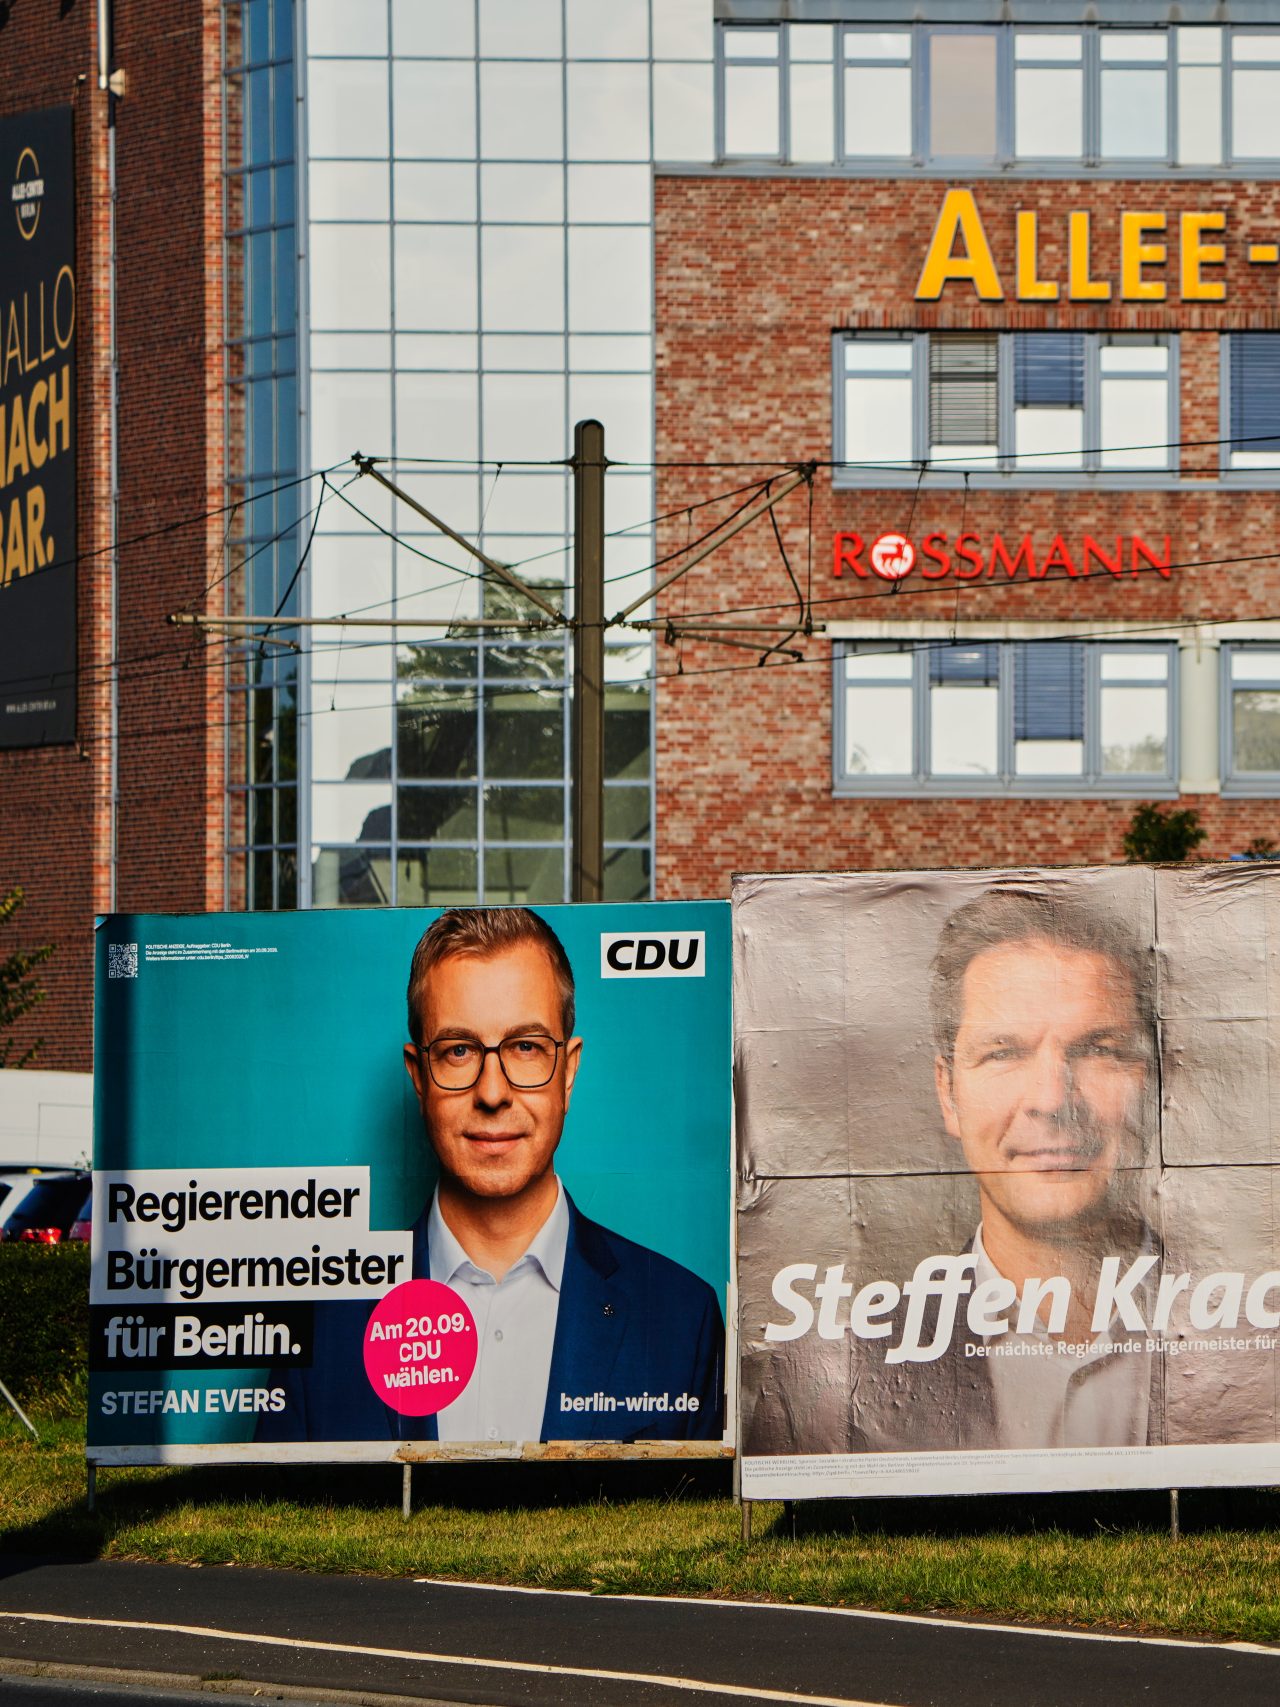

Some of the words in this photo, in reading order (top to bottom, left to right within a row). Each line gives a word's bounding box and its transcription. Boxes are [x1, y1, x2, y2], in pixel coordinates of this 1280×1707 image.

[0, 265, 75, 390] ALLO
[0, 364, 70, 488] ACH
[0, 485, 55, 588] AR.
[832, 531, 1172, 580] ROSSMANN
[606, 938, 699, 971] CDU
[108, 1178, 360, 1233] Regierender
[106, 1244, 405, 1300] Bürgermeister
[370, 1321, 403, 1342] Am
[405, 1312, 471, 1338] 20.09.
[764, 1253, 1072, 1365] Steffen
[104, 1315, 166, 1358] für
[174, 1312, 301, 1357] Berlin.
[399, 1339, 441, 1363] CDU
[965, 1343, 992, 1357] Der
[995, 1341, 1054, 1356] nächste
[1057, 1339, 1142, 1358] Regierende
[1145, 1336, 1251, 1356] Bürgermeister
[1254, 1335, 1278, 1351] für
[383, 1365, 460, 1389] wählen.
[101, 1389, 200, 1415] STEFAN
[205, 1387, 286, 1413] EVERS
[560, 1391, 700, 1412] berlin-wird.de
